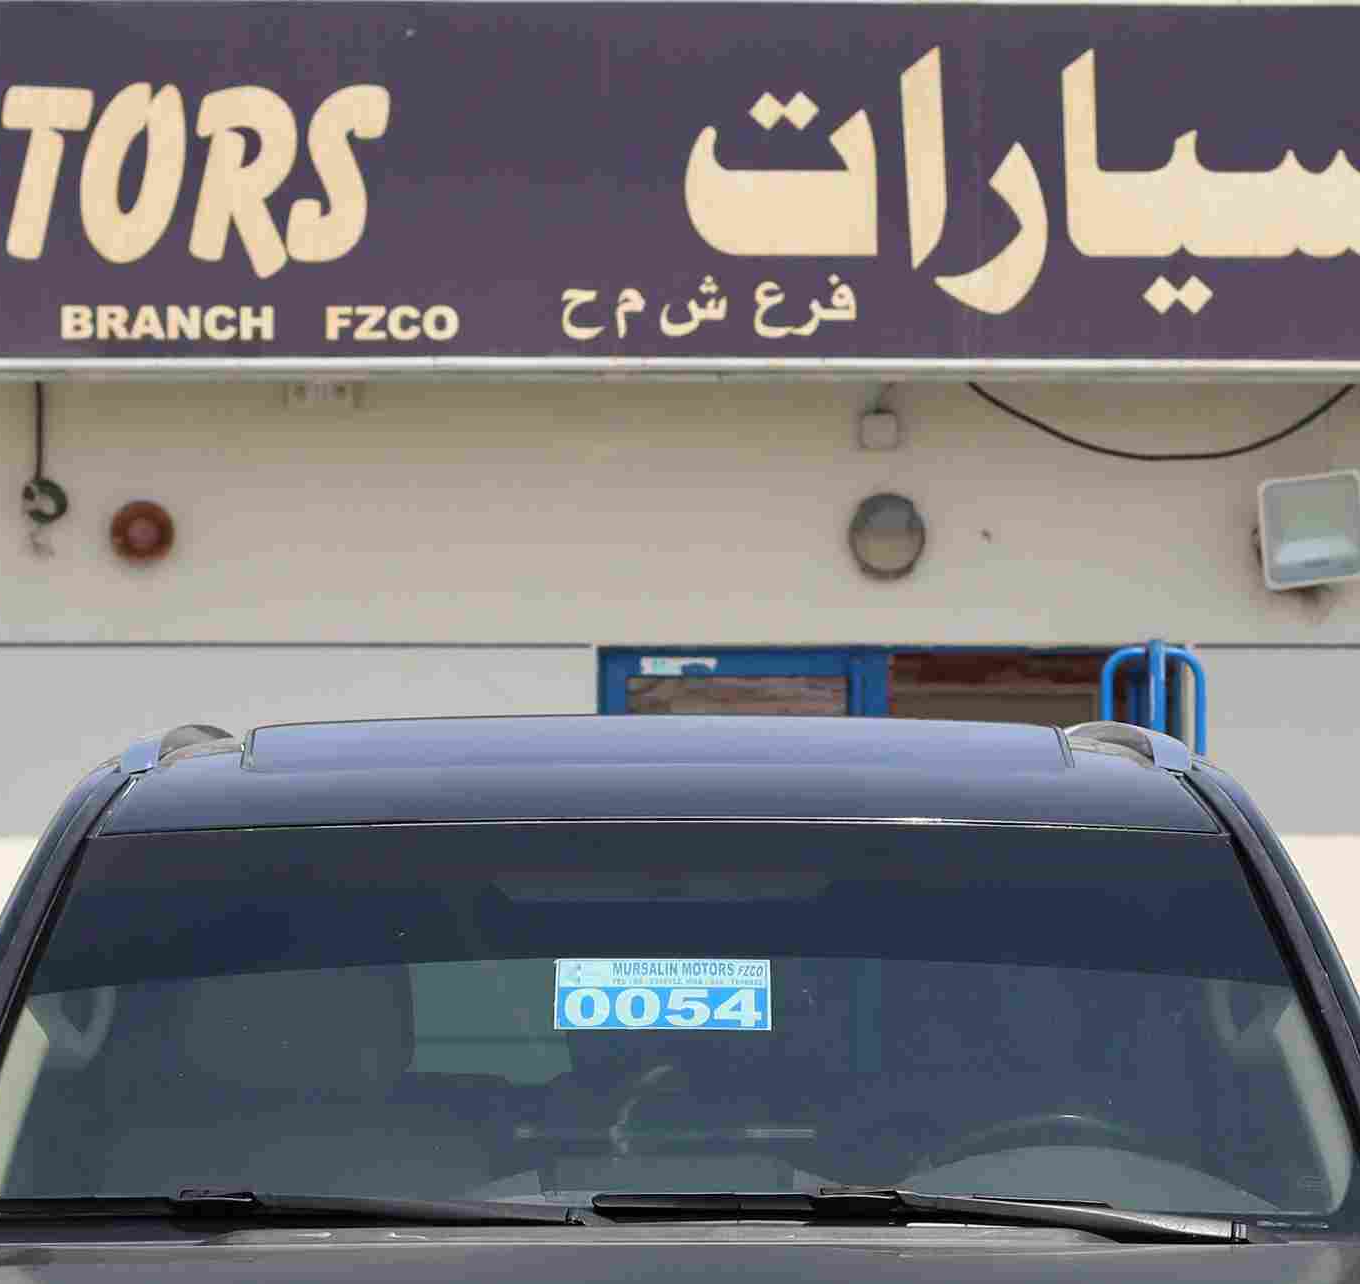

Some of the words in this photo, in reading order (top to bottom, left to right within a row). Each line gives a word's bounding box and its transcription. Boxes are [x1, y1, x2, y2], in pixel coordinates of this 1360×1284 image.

[60, 304, 275, 341] BRANCH
[325, 305, 460, 341] FZCO
[753, 273, 857, 339] فرع
[612, 962, 679, 977] MURSALIN
[682, 962, 735, 977] MOTORS
[737, 965, 764, 977] FZCO
[563, 987, 762, 1027] 0054
